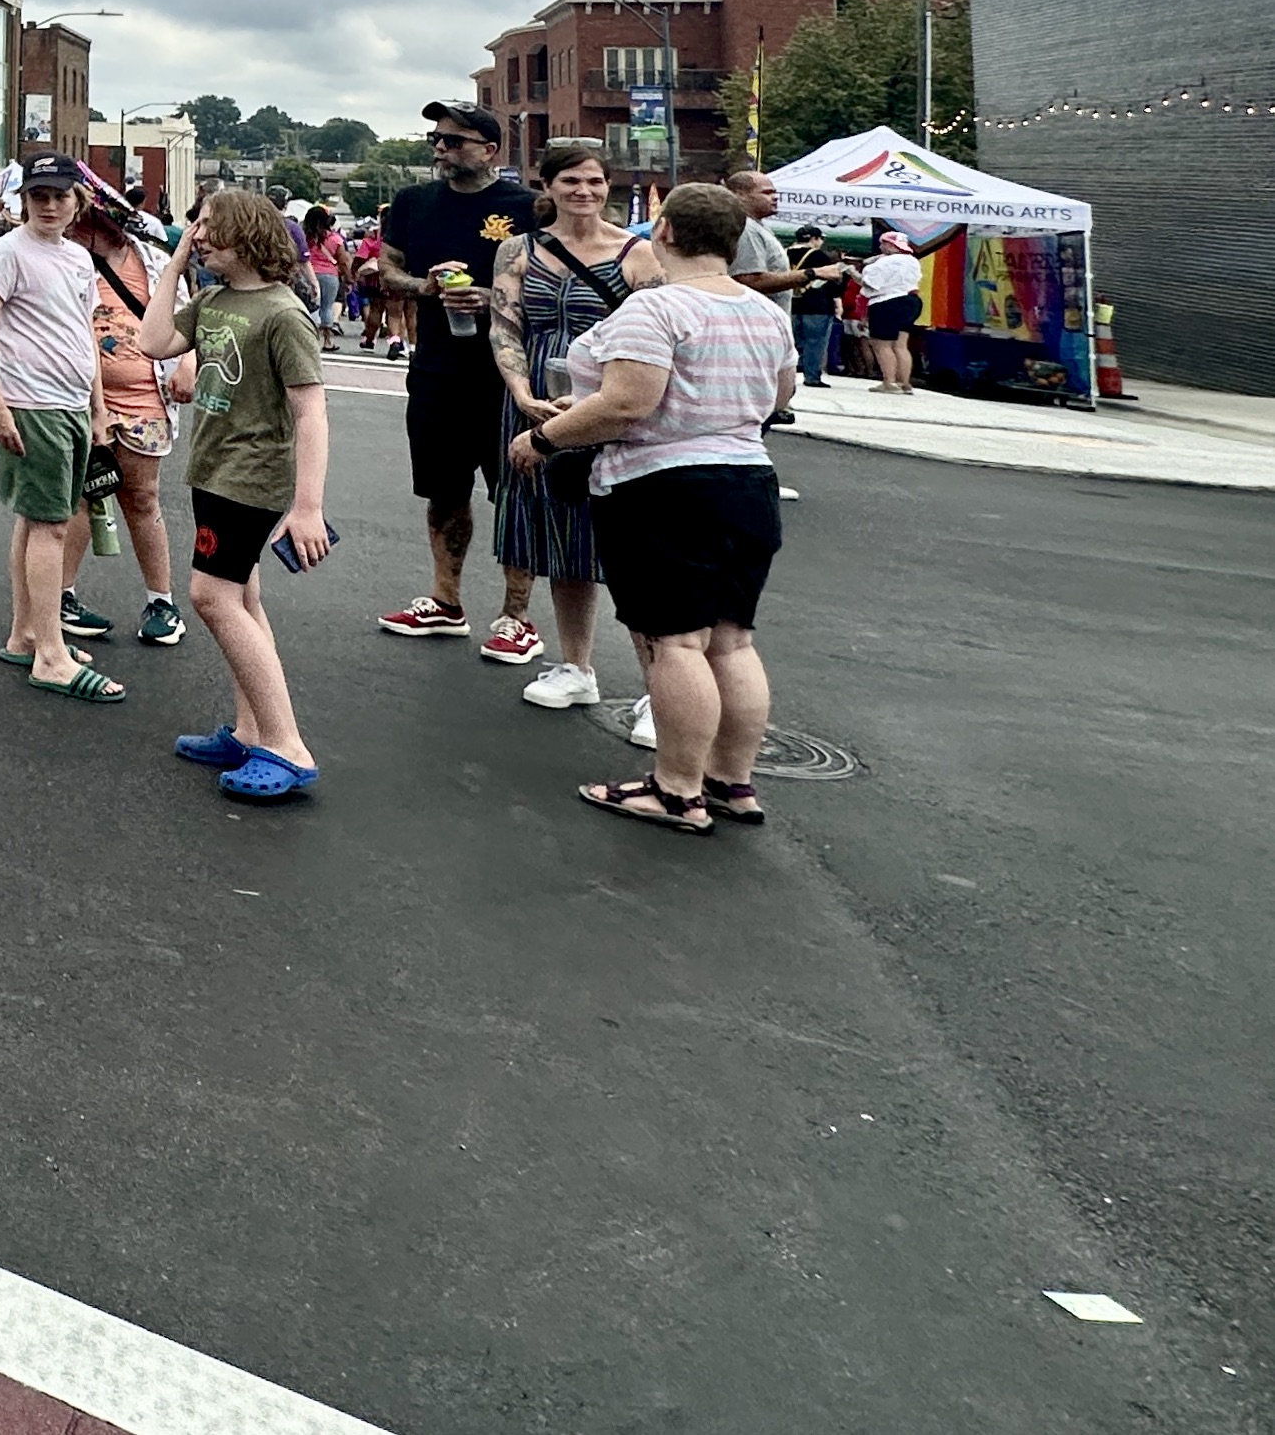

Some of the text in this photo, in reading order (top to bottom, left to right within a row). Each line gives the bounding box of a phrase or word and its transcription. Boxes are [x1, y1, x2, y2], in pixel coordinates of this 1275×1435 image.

[778, 191, 1073, 222] TRIAD PRIDE PERFORMING ARTS
